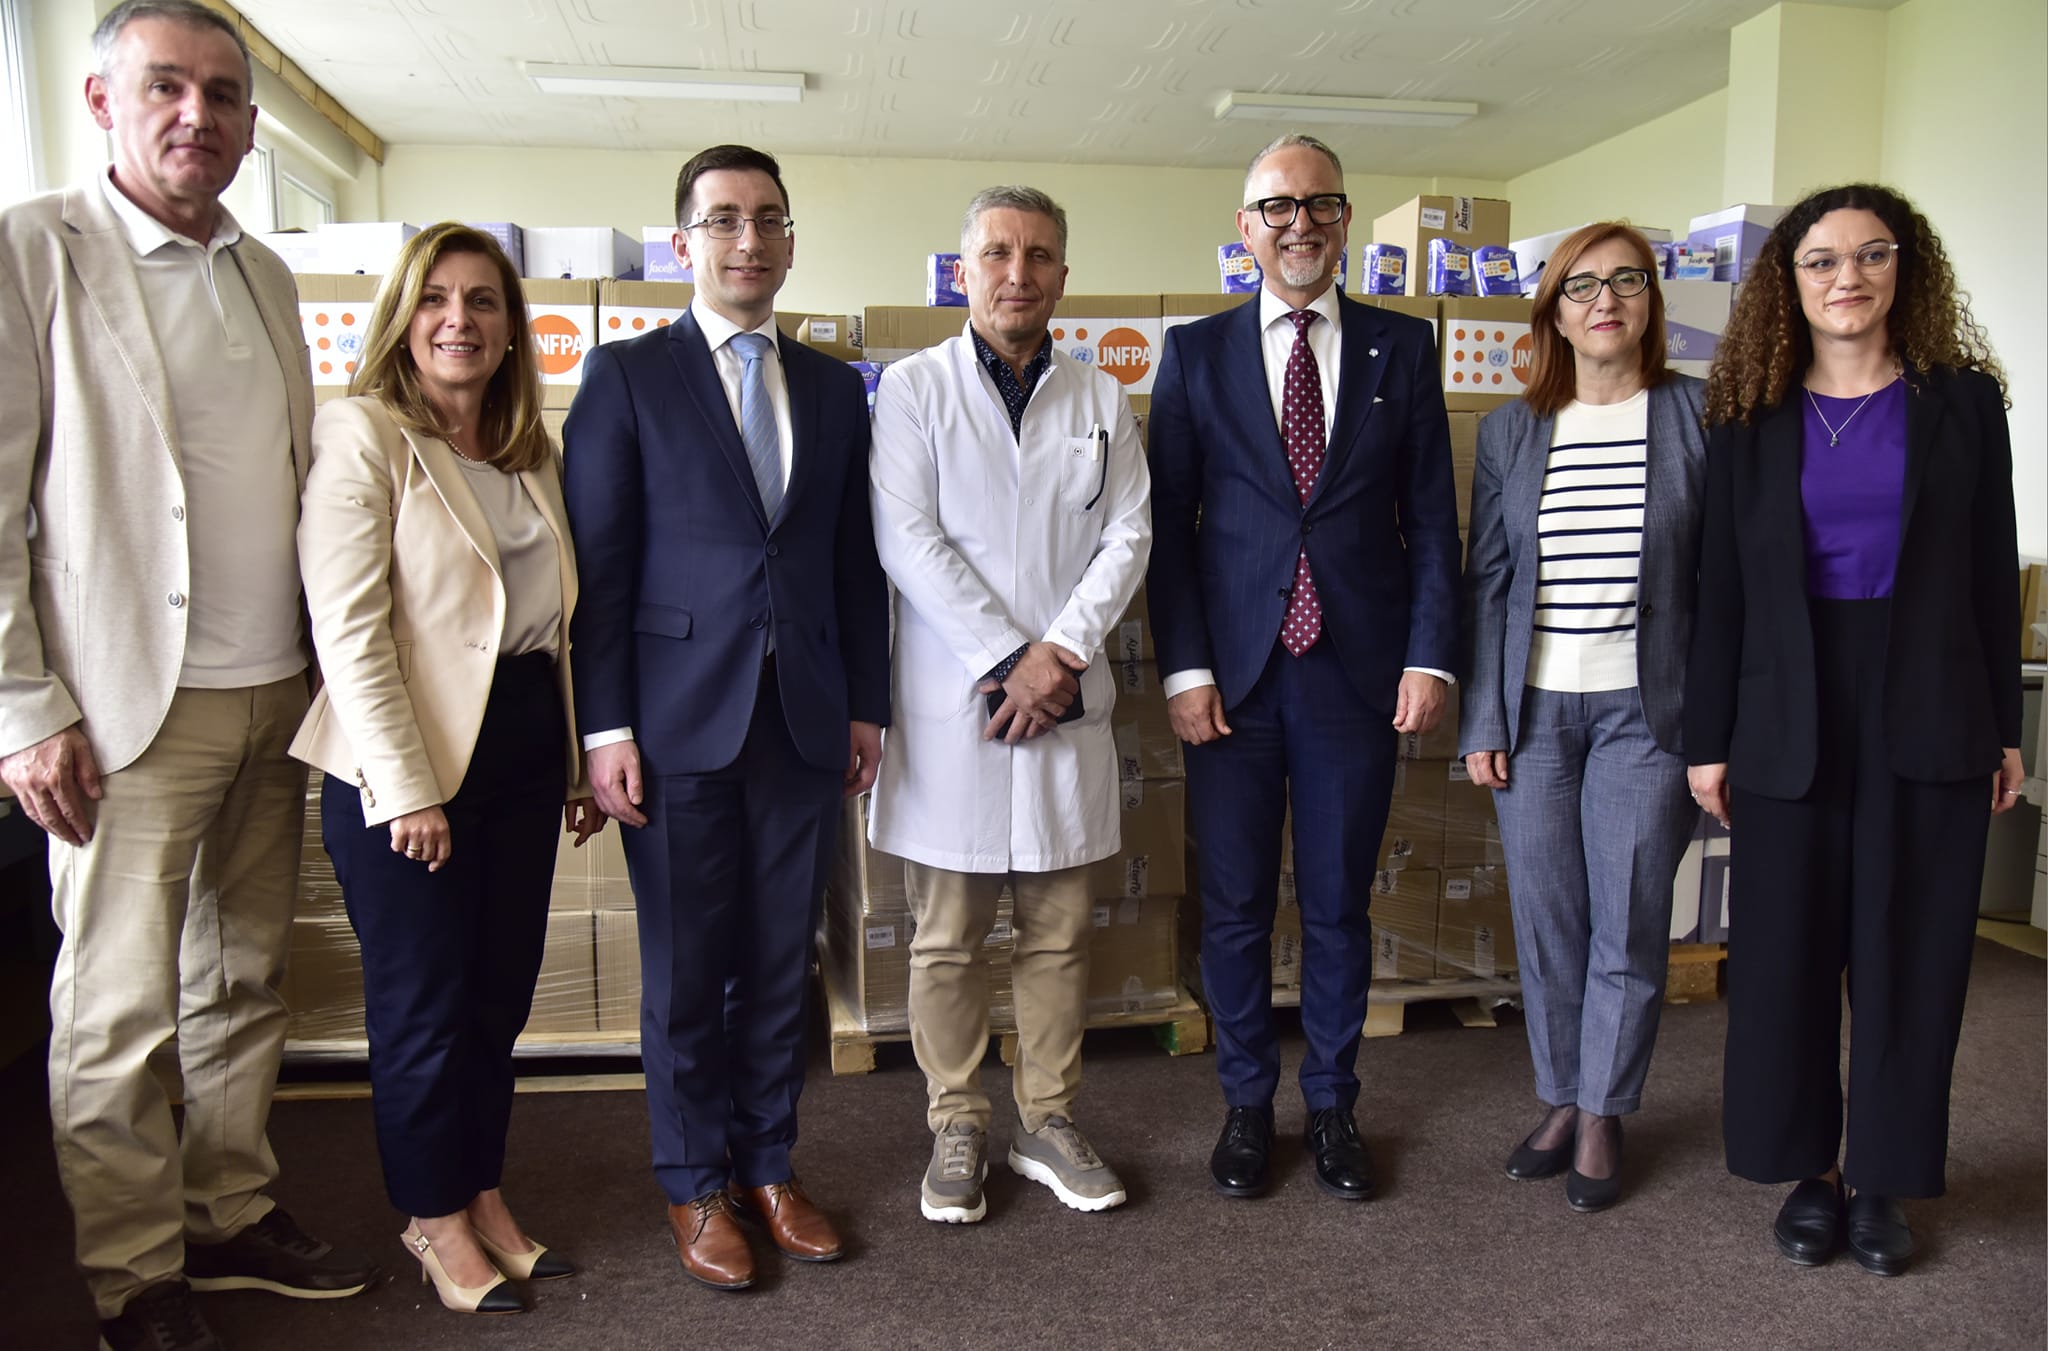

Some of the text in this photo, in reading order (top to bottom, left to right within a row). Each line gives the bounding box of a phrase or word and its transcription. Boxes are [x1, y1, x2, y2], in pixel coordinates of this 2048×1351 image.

[1458, 197, 1468, 231] Butter
[852, 315, 863, 350] Butterf
[1666, 332, 1688, 354] elle
[535, 333, 583, 356] NFPA
[1097, 346, 1151, 366] UNFPA
